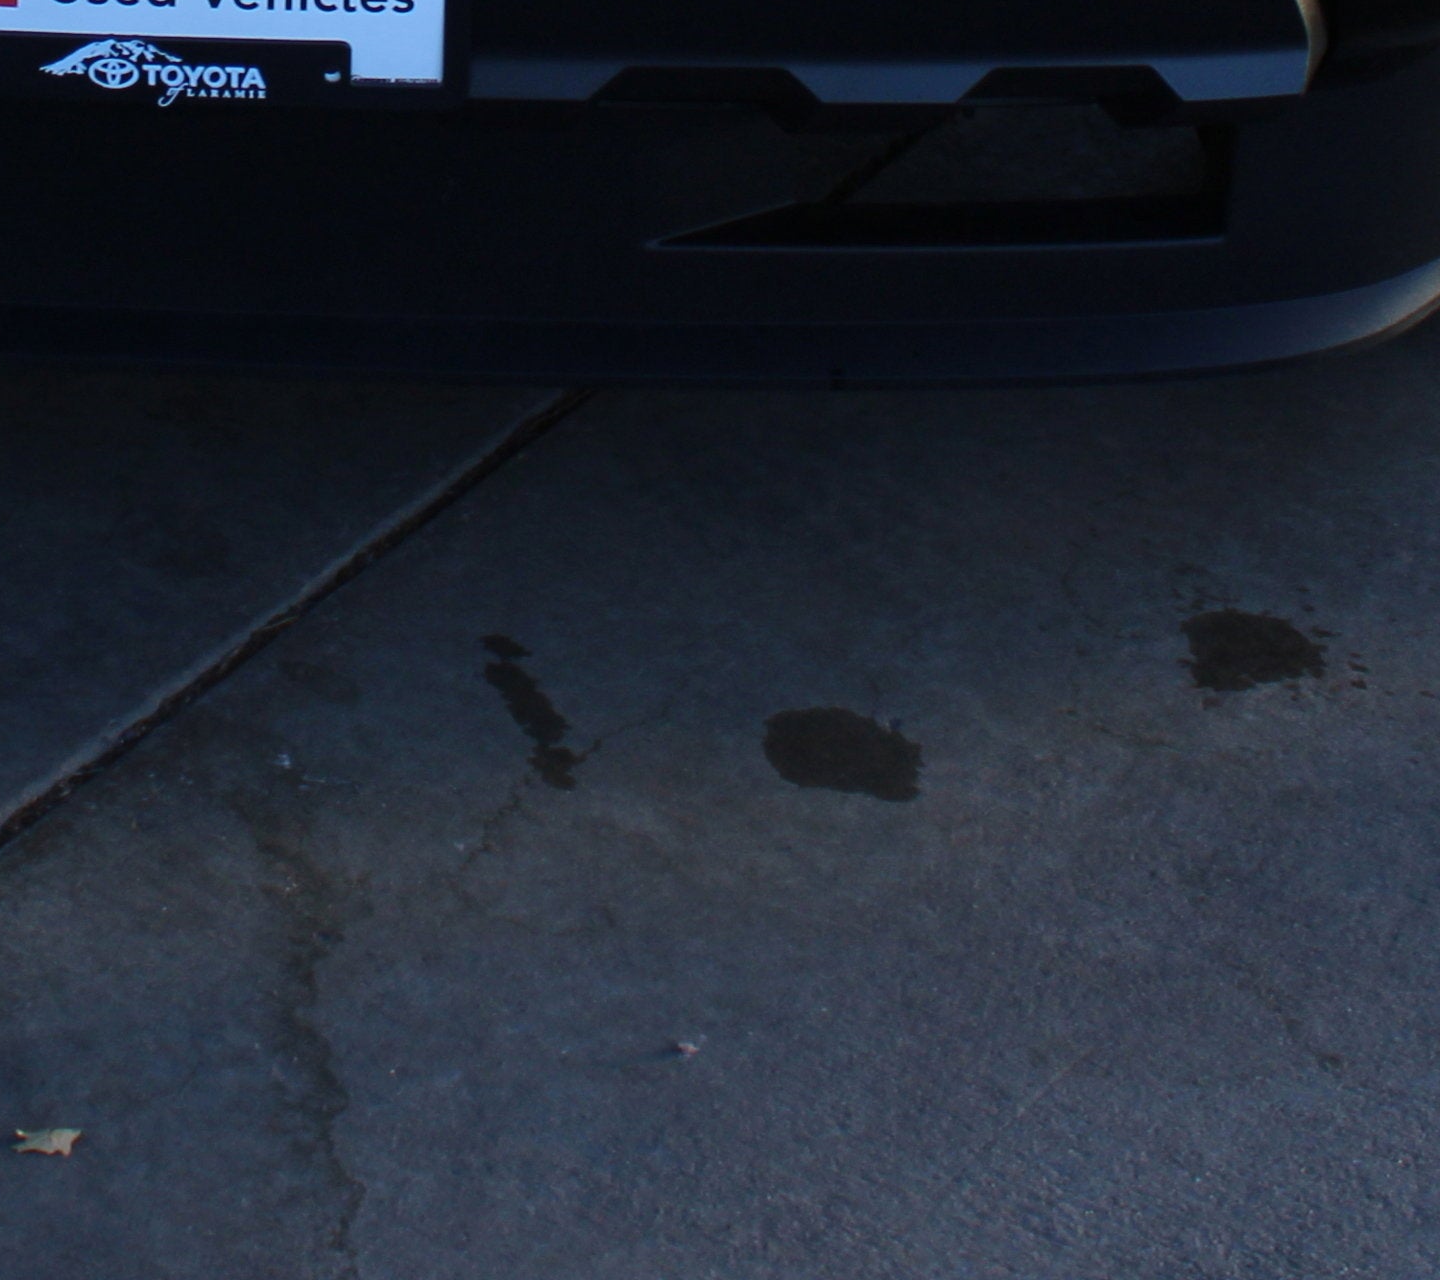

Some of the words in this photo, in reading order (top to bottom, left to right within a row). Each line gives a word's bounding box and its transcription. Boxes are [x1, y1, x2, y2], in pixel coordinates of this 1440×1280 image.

[141, 64, 267, 90] TOYOTA
[157, 83, 189, 107] of
[187, 89, 267, 100] LARAMIE
